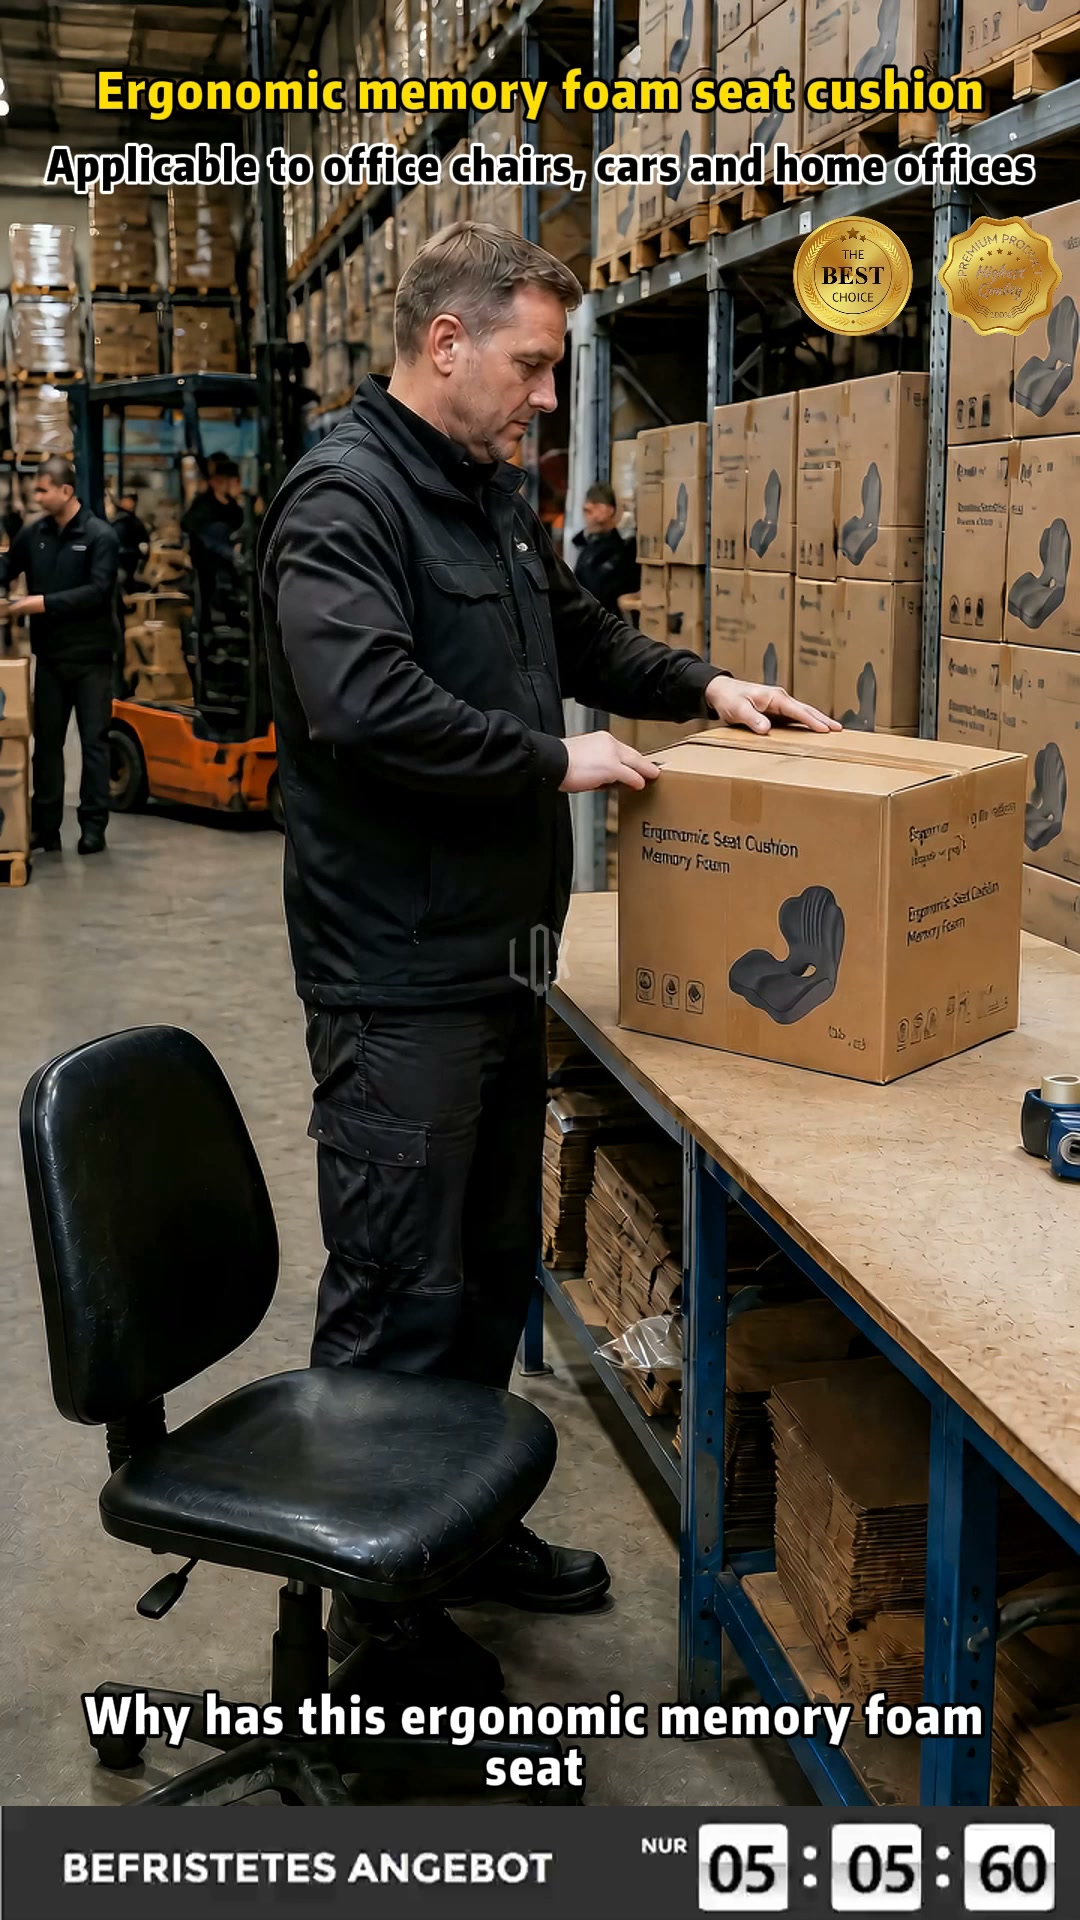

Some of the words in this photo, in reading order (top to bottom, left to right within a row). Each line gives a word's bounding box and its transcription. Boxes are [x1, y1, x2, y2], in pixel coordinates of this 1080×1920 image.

[713, 831, 742, 850] Seat
[745, 835, 799, 858] Cushion
[641, 846, 693, 871] Memory
